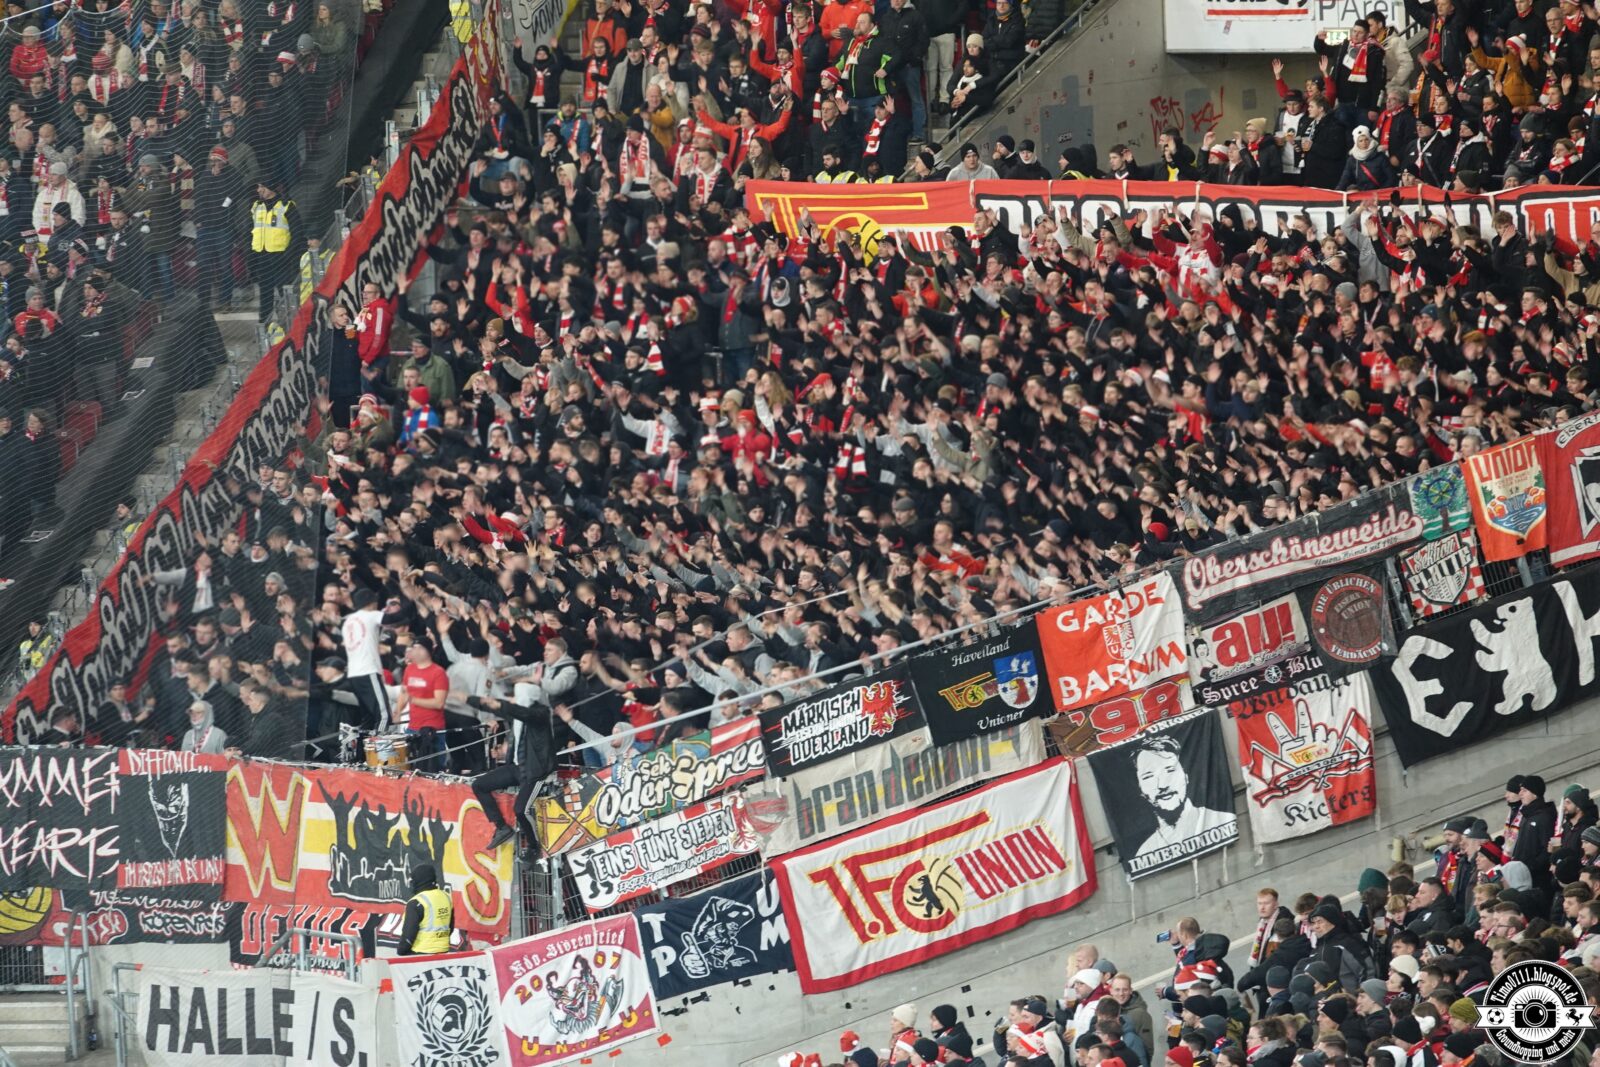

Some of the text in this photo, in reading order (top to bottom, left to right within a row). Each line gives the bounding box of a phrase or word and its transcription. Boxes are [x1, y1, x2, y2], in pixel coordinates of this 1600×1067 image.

[1184, 502, 1420, 604] Oberschöneweide
[1056, 581, 1165, 633] GARDE
[1315, 577, 1376, 613] DIE ÜBLICHEN
[952, 635, 1011, 667] Havelland
[1058, 640, 1186, 706] BARNIM
[1202, 676, 1260, 704] Spree
[781, 686, 863, 740] MÄRKISCH
[977, 709, 1025, 730] Unioner
[790, 716, 872, 766] ODERLAND
[639, 753, 674, 780] Sek
[1285, 784, 1372, 828] Kickers
[592, 805, 736, 881] EINS FÜNF SIEBEN
[954, 824, 1067, 901] UNION
[1128, 844, 1182, 873] IMMER
[407, 965, 491, 993] SIXTY
